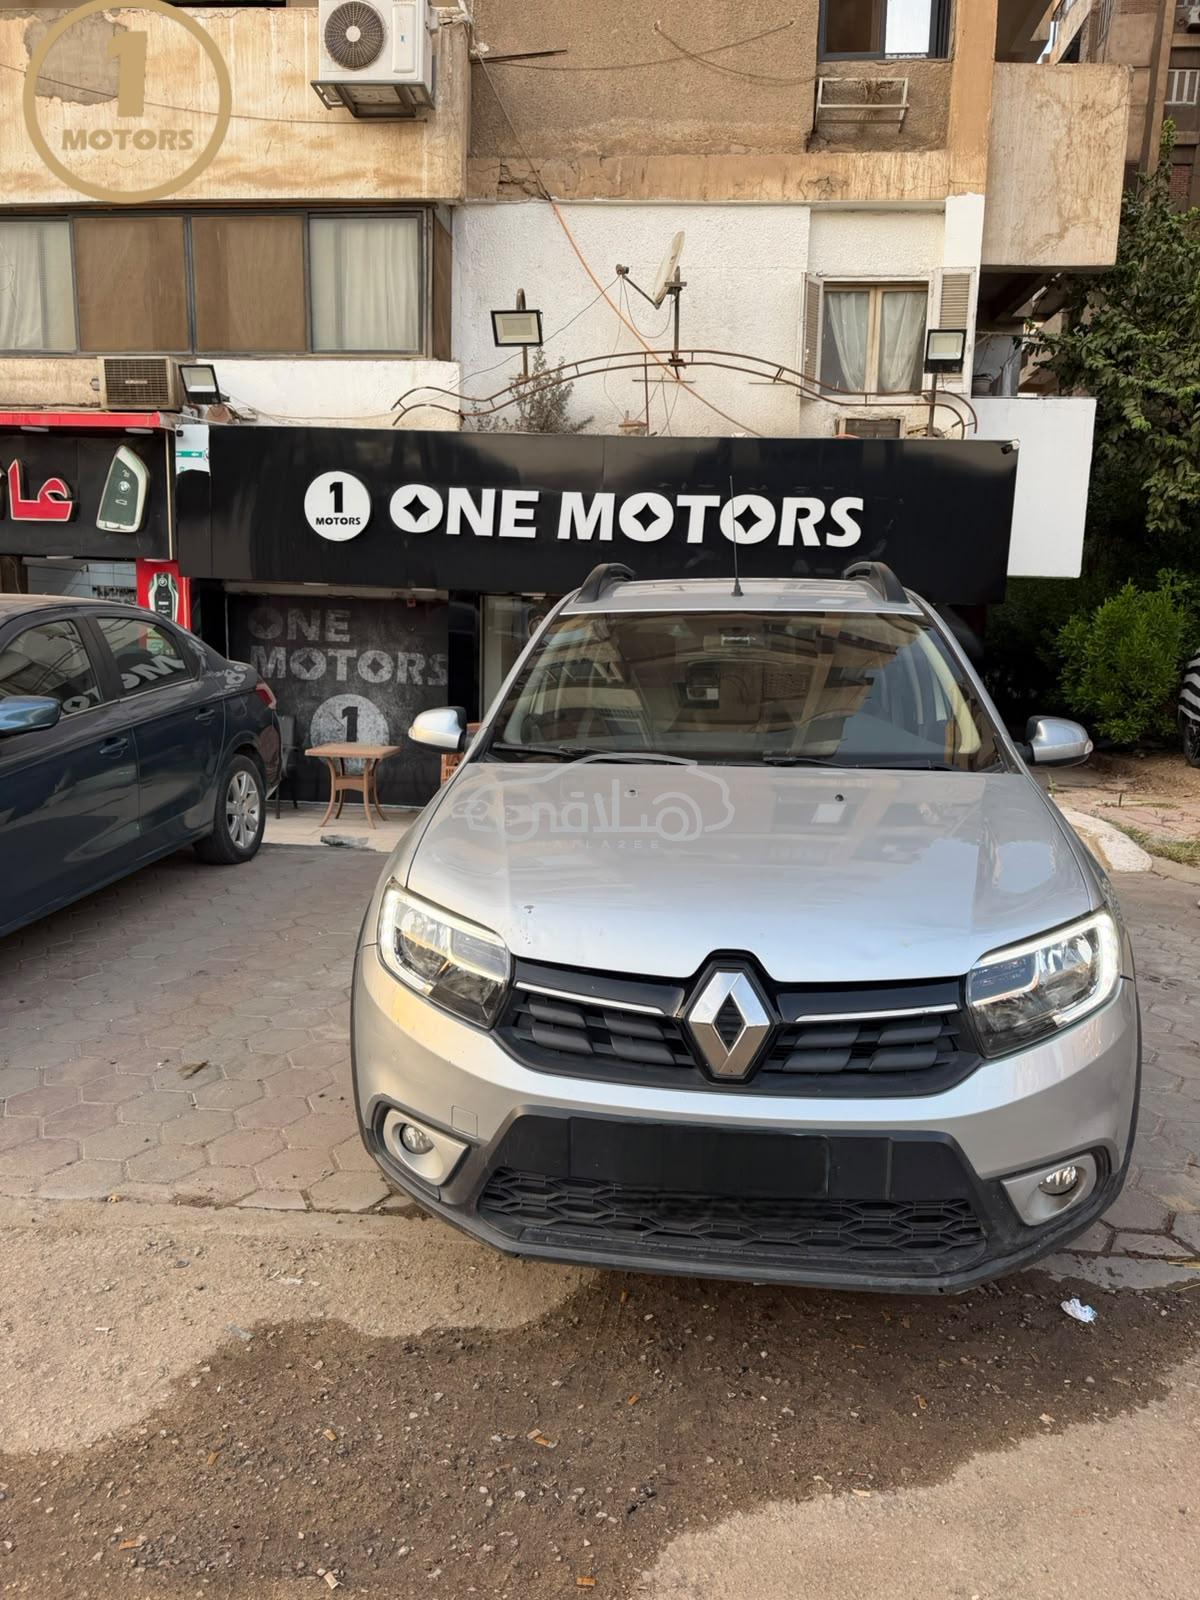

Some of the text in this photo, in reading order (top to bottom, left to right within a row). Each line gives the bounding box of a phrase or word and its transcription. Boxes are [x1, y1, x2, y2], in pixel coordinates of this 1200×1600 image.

[0, 458, 73, 522] عا
[329, 481, 344, 513] 1
[315, 516, 361, 526] MOTORS
[389, 483, 864, 548] ONE MOTORS
[250, 608, 351, 643] ONE
[251, 645, 448, 686] MOTORS
[341, 705, 359, 742] 1
